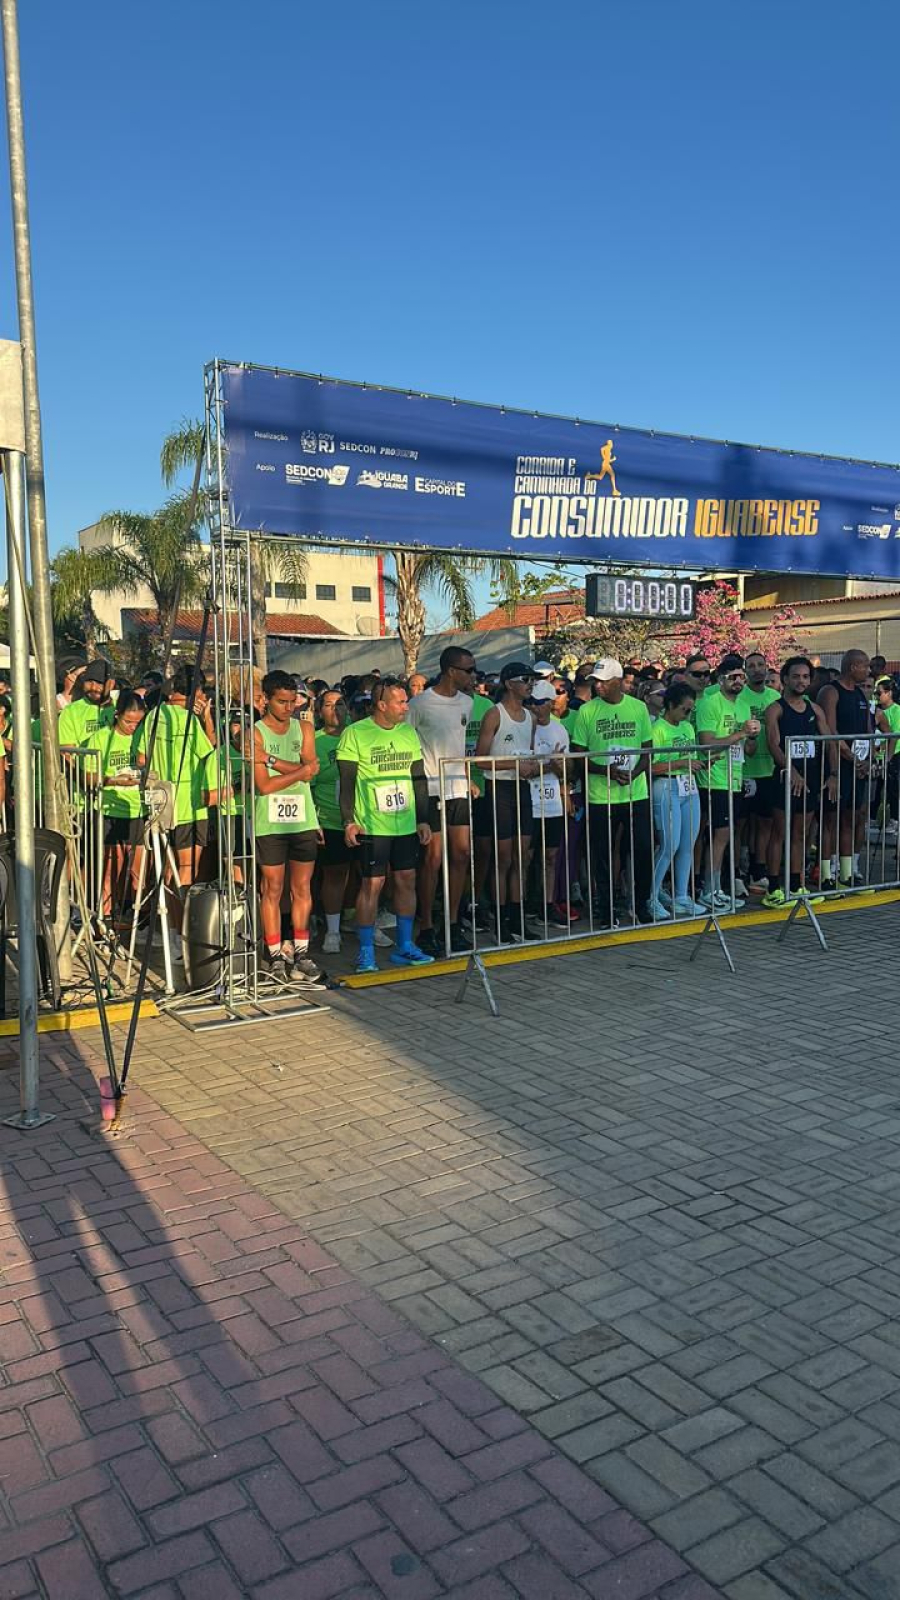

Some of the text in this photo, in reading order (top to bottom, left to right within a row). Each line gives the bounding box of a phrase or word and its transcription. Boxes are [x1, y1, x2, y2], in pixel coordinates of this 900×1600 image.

[319, 440, 335, 453] RJ
[340, 442, 376, 454] SEDCON
[256, 464, 276, 472] Apoio
[285, 464, 332, 479] SEDCON
[516, 456, 576, 475] CORRIDA E
[375, 470, 408, 482] IGUABA
[514, 476, 597, 495] CAMINHADA DO
[510, 495, 820, 538] CONSUMIDOR IGUABENSE
[386, 792, 405, 807] 816
[278, 804, 298, 817] 202
